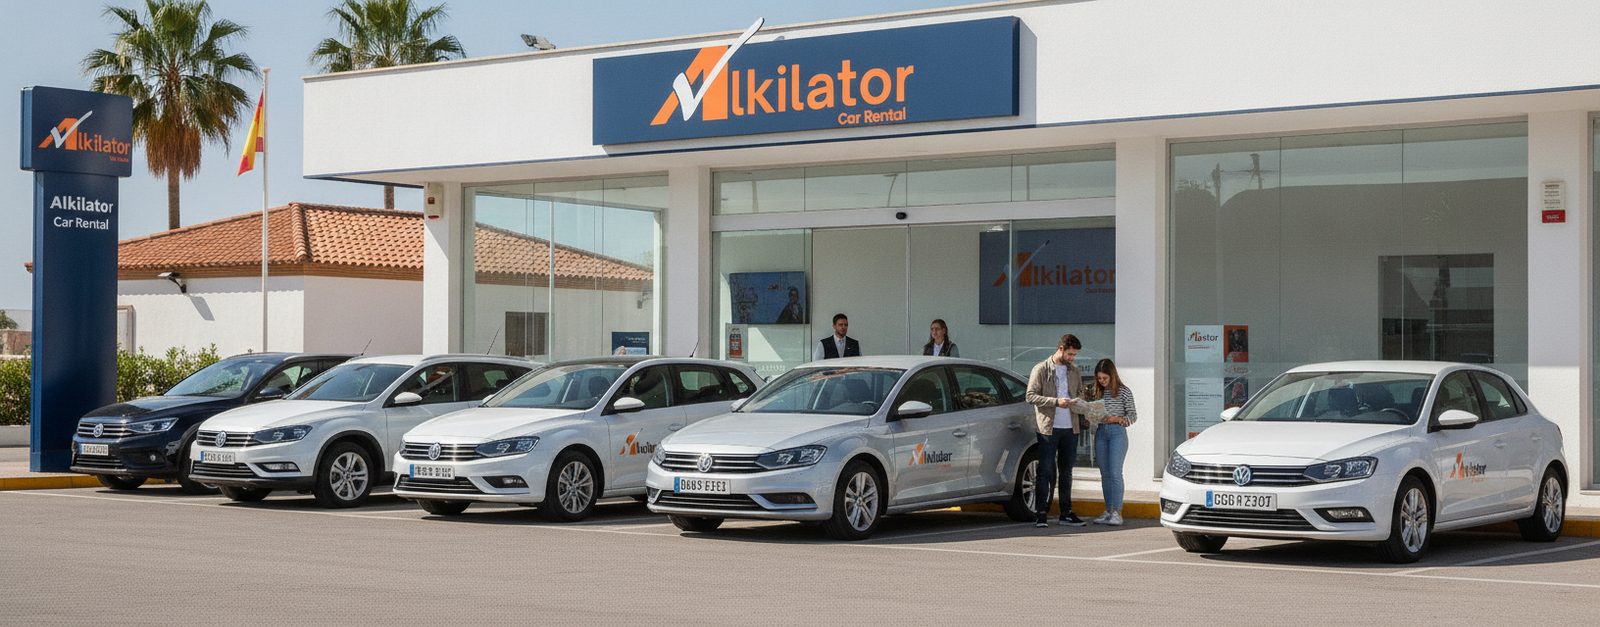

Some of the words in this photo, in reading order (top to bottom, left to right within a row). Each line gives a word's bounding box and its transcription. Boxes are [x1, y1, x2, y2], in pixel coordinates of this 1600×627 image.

[650, 44, 915, 126] Alkilator
[837, 112, 862, 125] Car
[864, 106, 907, 123] Rental
[38, 117, 131, 155] Alkilator
[50, 195, 114, 213] Alkilator
[53, 216, 74, 228] Car
[75, 217, 109, 230] Rental
